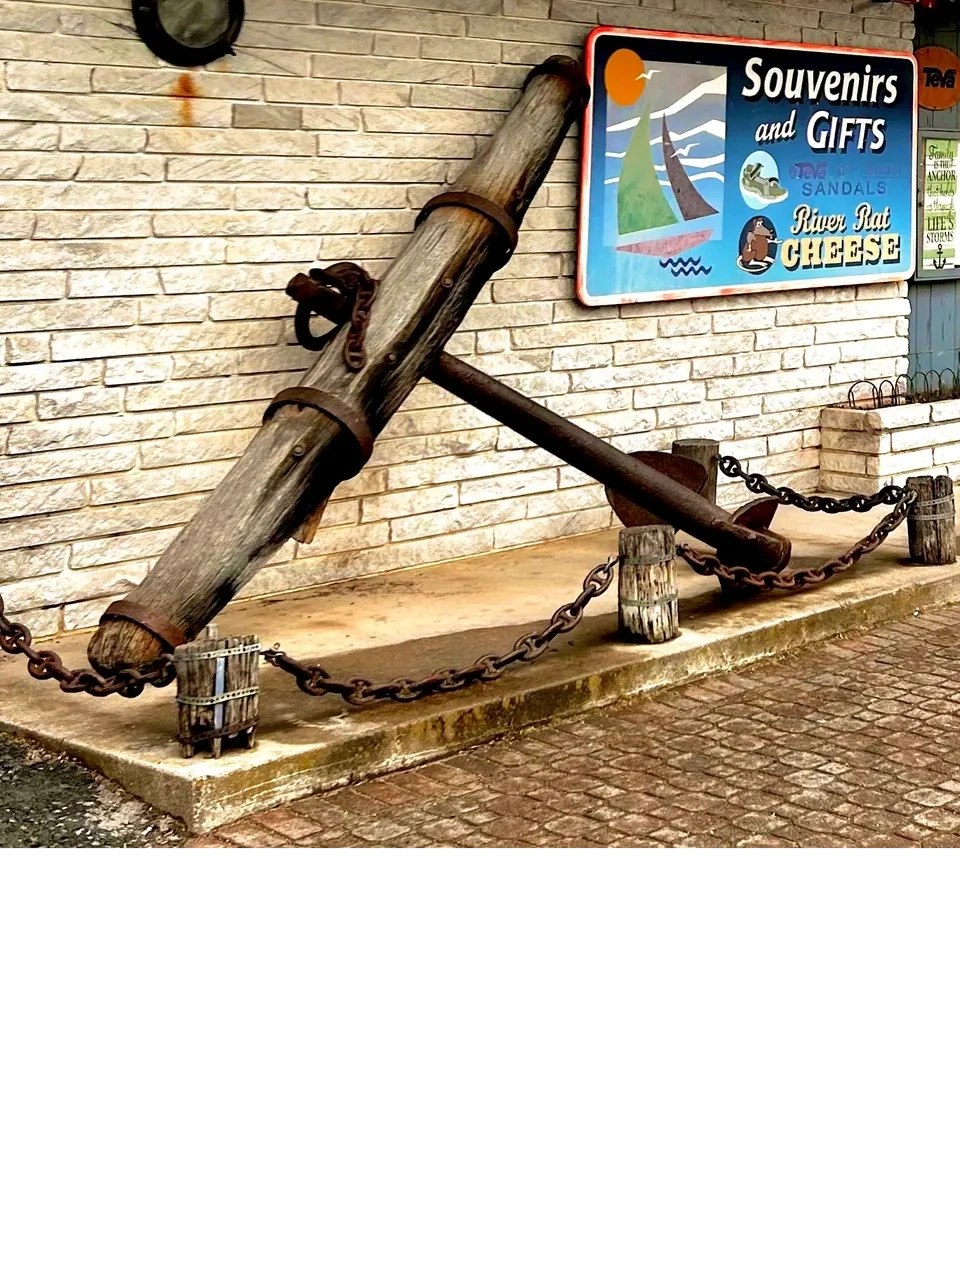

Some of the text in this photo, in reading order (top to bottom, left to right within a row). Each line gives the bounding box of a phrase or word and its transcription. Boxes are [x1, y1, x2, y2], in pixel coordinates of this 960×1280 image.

[741, 56, 898, 105] Souvenirs
[754, 109, 886, 151] and GIFTS
[801, 181, 887, 197] SANDALS
[926, 170, 957, 182] ANCHOR
[790, 204, 846, 235] River
[852, 202, 891, 232] Rat
[779, 233, 900, 268] CHEESE
[926, 231, 954, 244] STORMS
